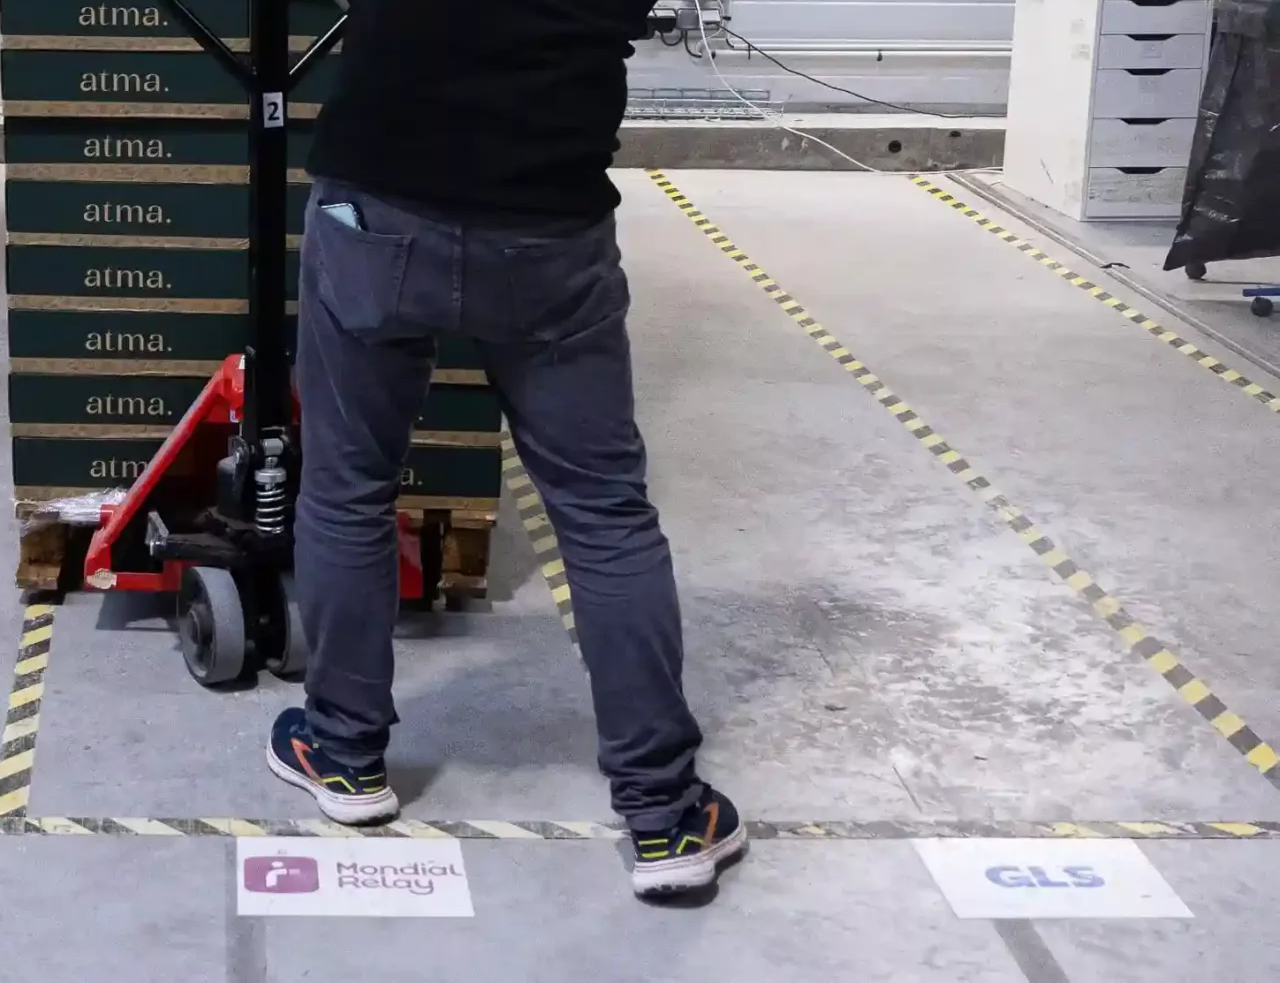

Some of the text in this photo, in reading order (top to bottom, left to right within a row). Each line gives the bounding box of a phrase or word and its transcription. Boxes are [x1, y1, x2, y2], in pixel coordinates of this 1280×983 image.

[78, 3, 169, 27] atma.
[79, 68, 170, 93] atma.
[267, 101, 280, 121] 2
[83, 135, 172, 158] atma.
[83, 199, 172, 224] atma.
[83, 265, 172, 289] atma.
[85, 330, 173, 353] atma.
[86, 393, 173, 417] atma.
[90, 457, 148, 478] atm
[337, 862, 463, 877] Mondial
[984, 866, 1106, 888] GLS
[338, 875, 434, 896] Relay
